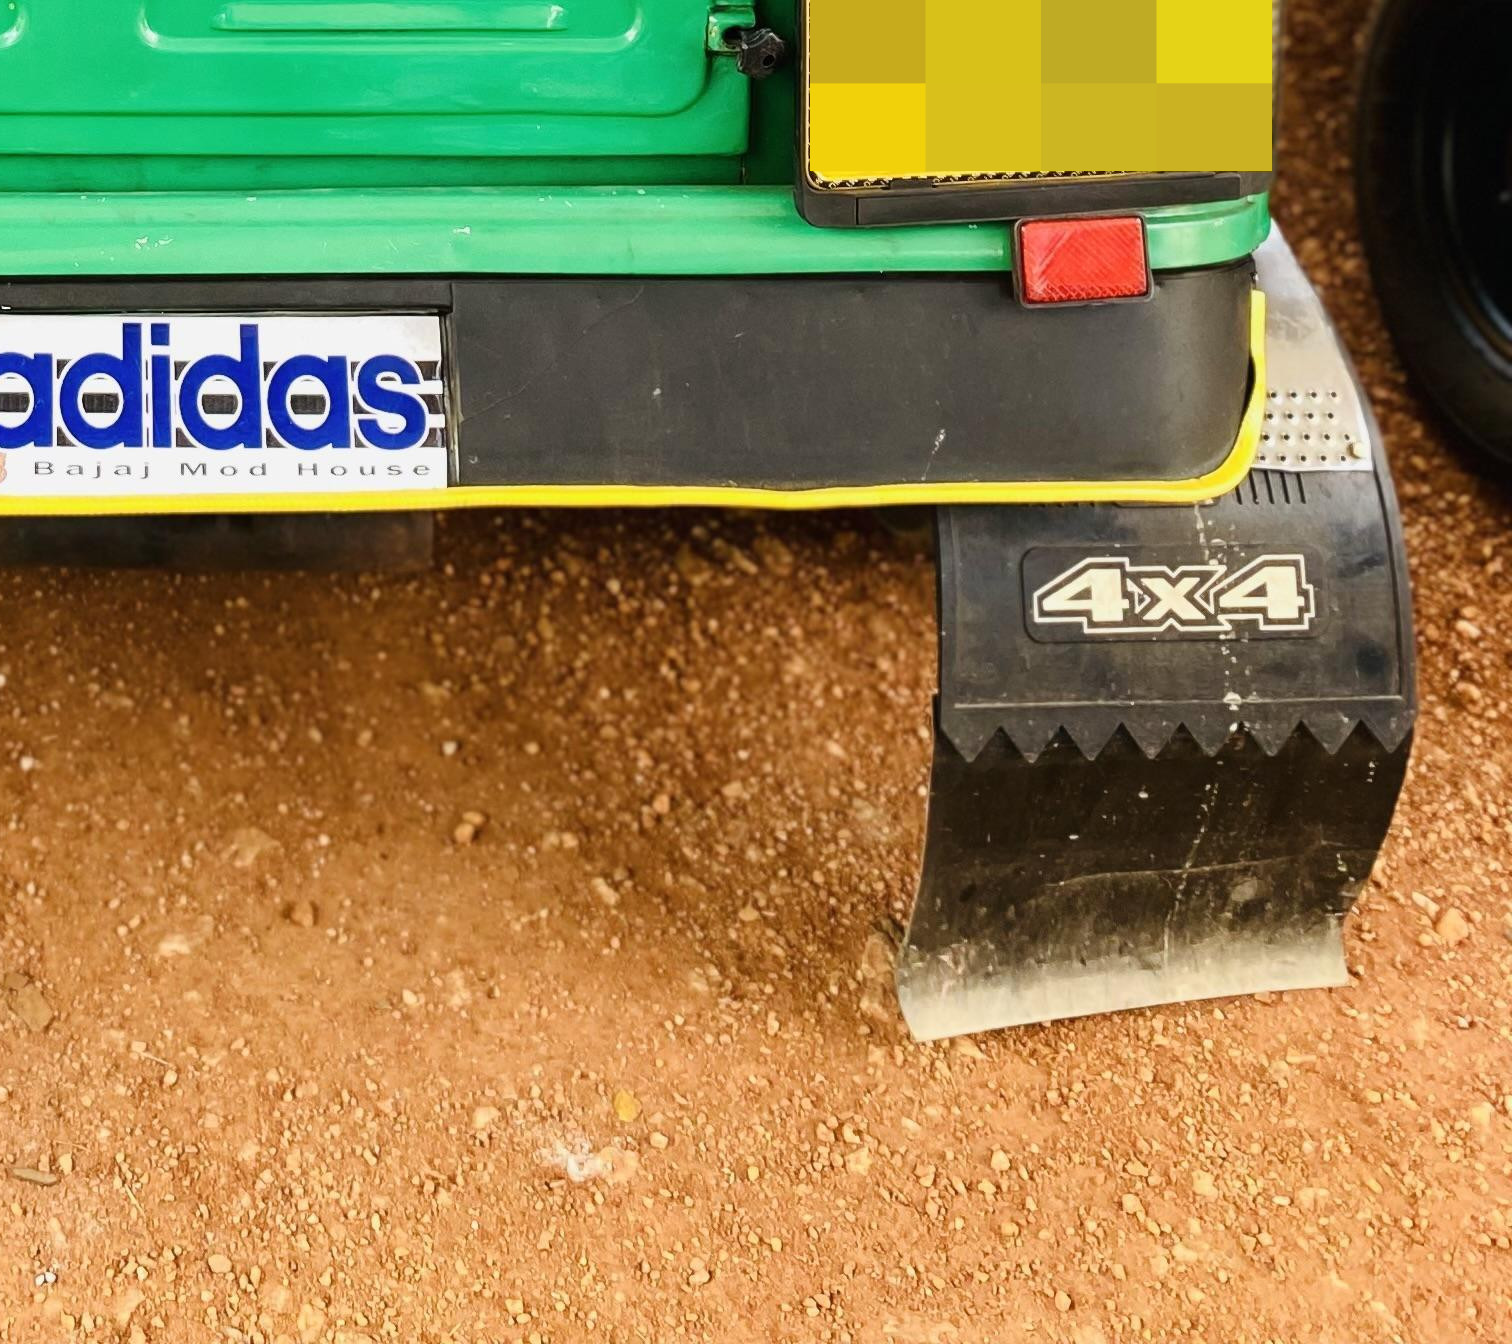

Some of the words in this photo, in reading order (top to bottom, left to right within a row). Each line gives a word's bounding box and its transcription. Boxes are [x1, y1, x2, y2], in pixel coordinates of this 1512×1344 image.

[34, 460, 152, 479] Bajaj
[179, 460, 268, 478] Mod
[297, 460, 432, 478] House
[1033, 554, 1315, 633] 4x4
